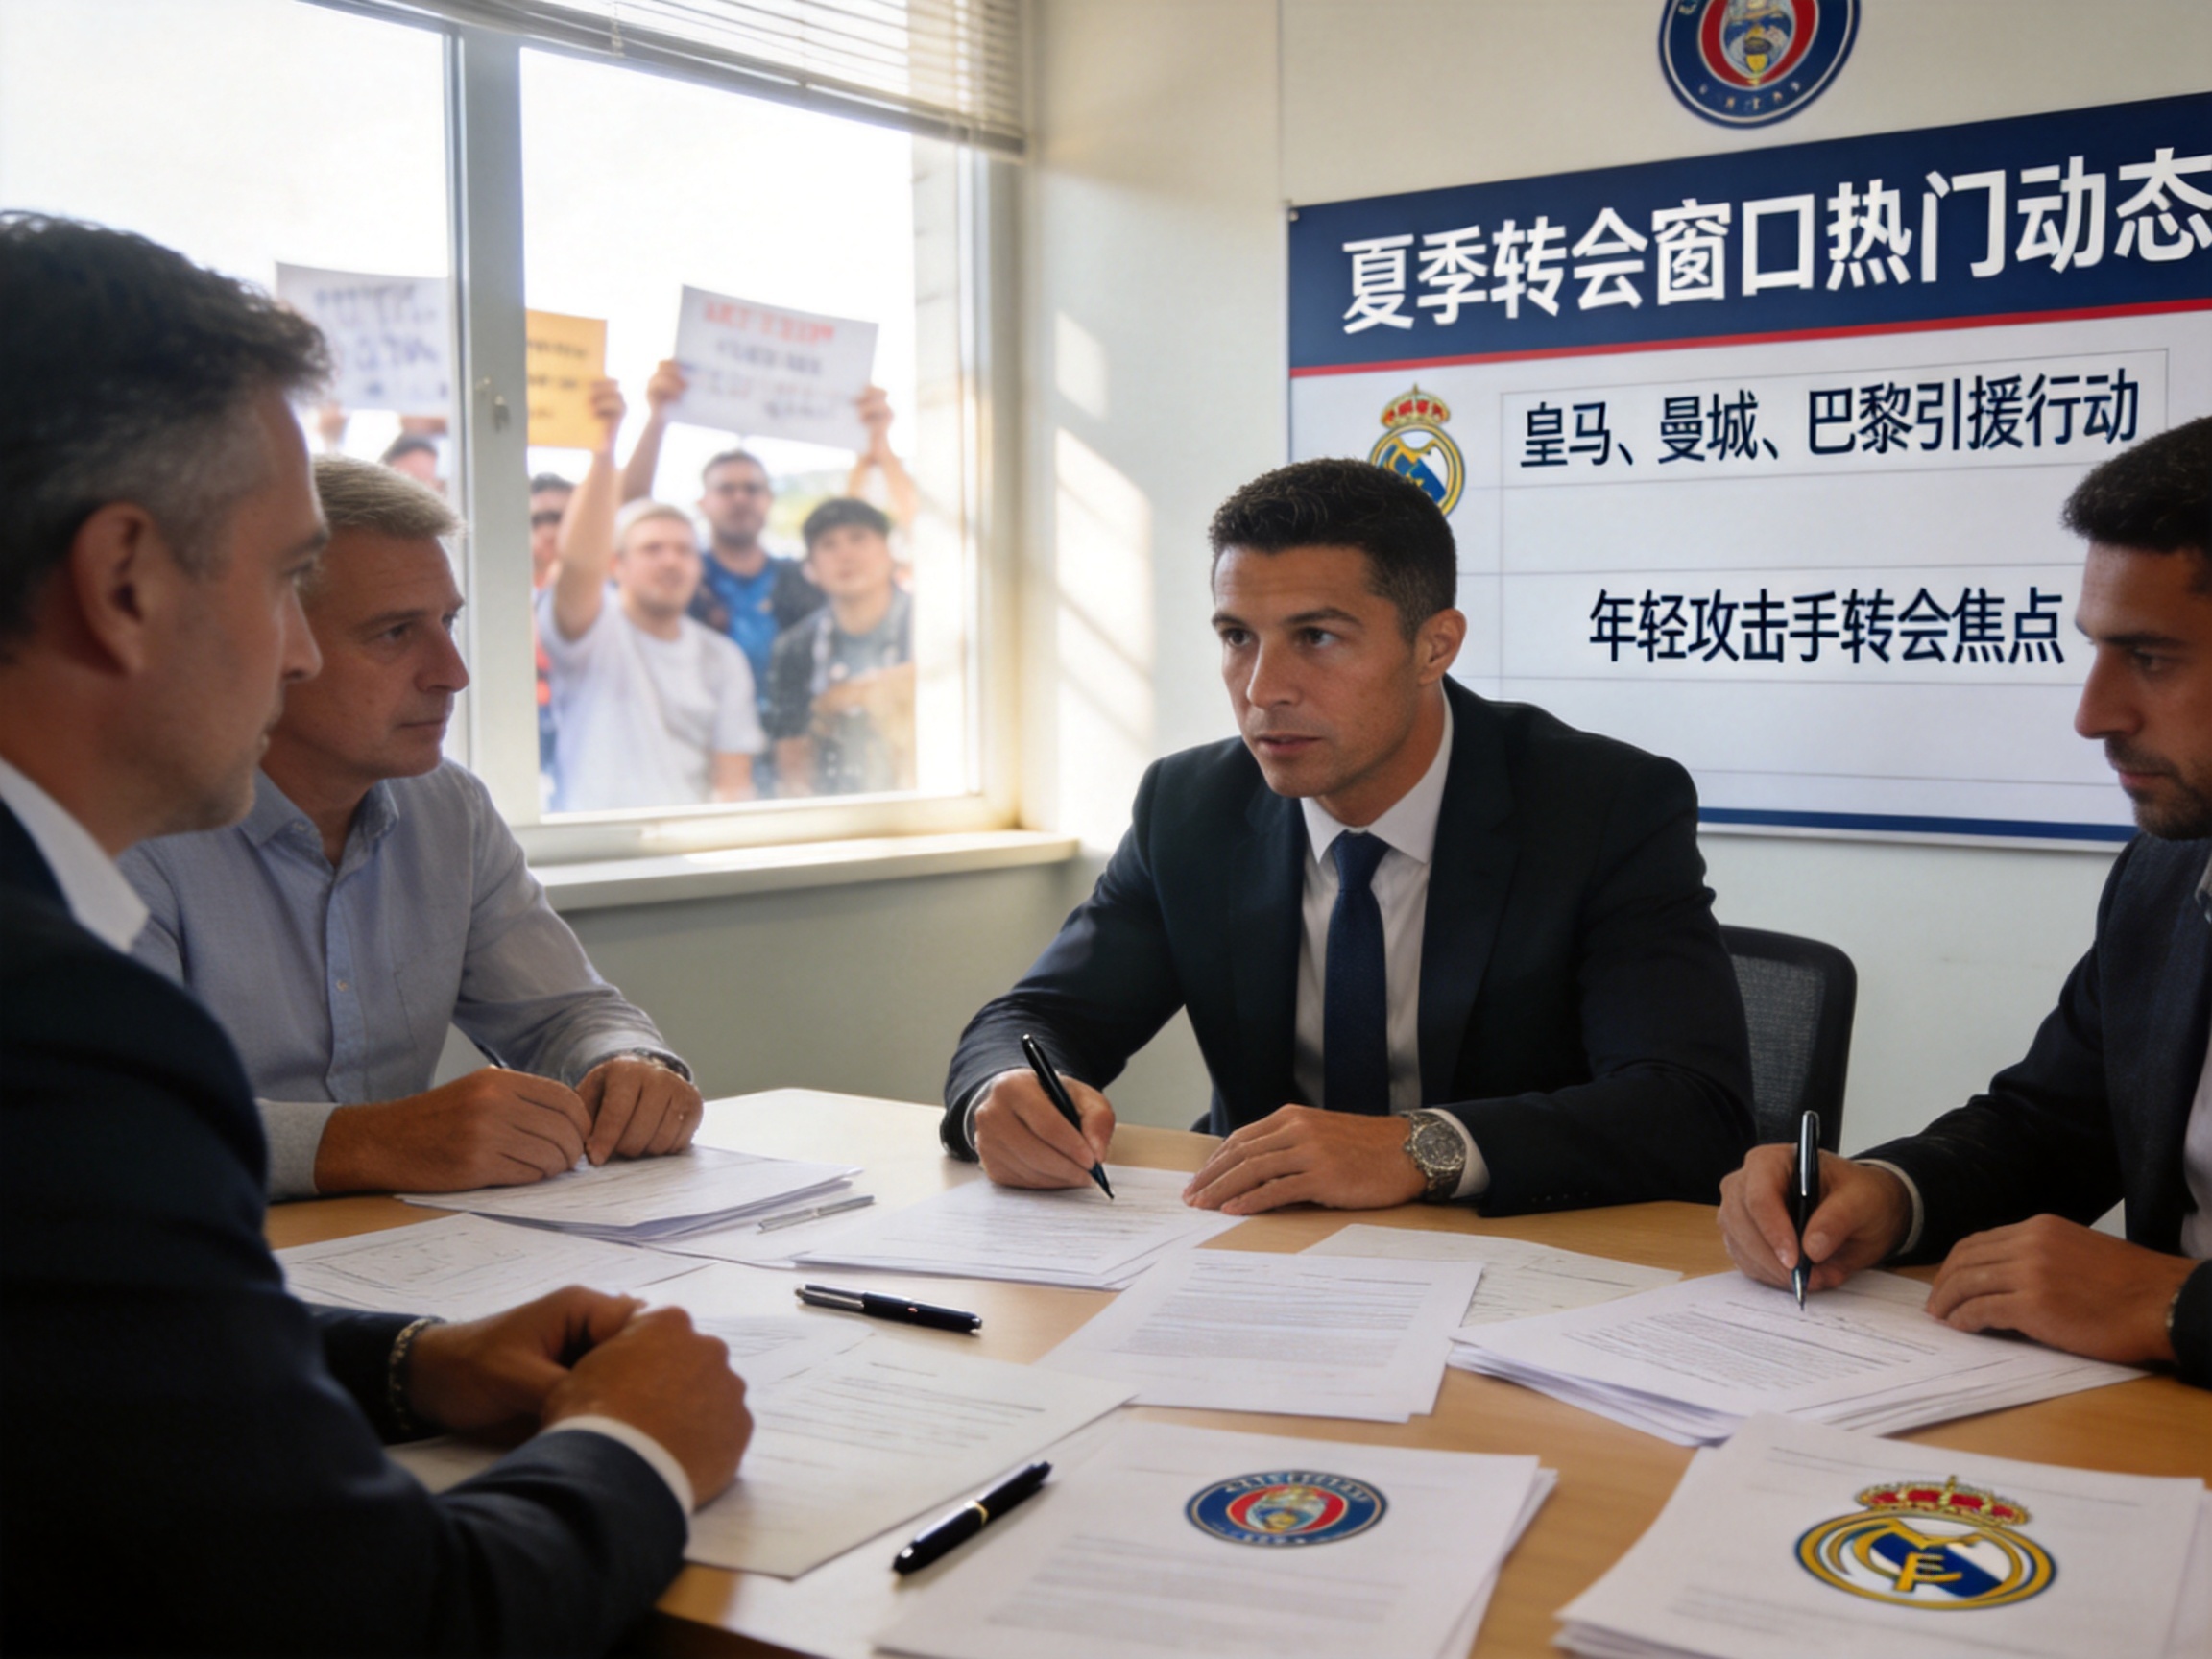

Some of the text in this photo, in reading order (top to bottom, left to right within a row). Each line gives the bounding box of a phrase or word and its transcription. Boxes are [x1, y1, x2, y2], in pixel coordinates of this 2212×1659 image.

[1342, 147, 2212, 334] 夏季转会窗口热门动态
[1520, 368, 2139, 468] 皇马、曼城、巴黎引援行动
[1589, 586, 2064, 664] 年轻攻击手转会焦点
